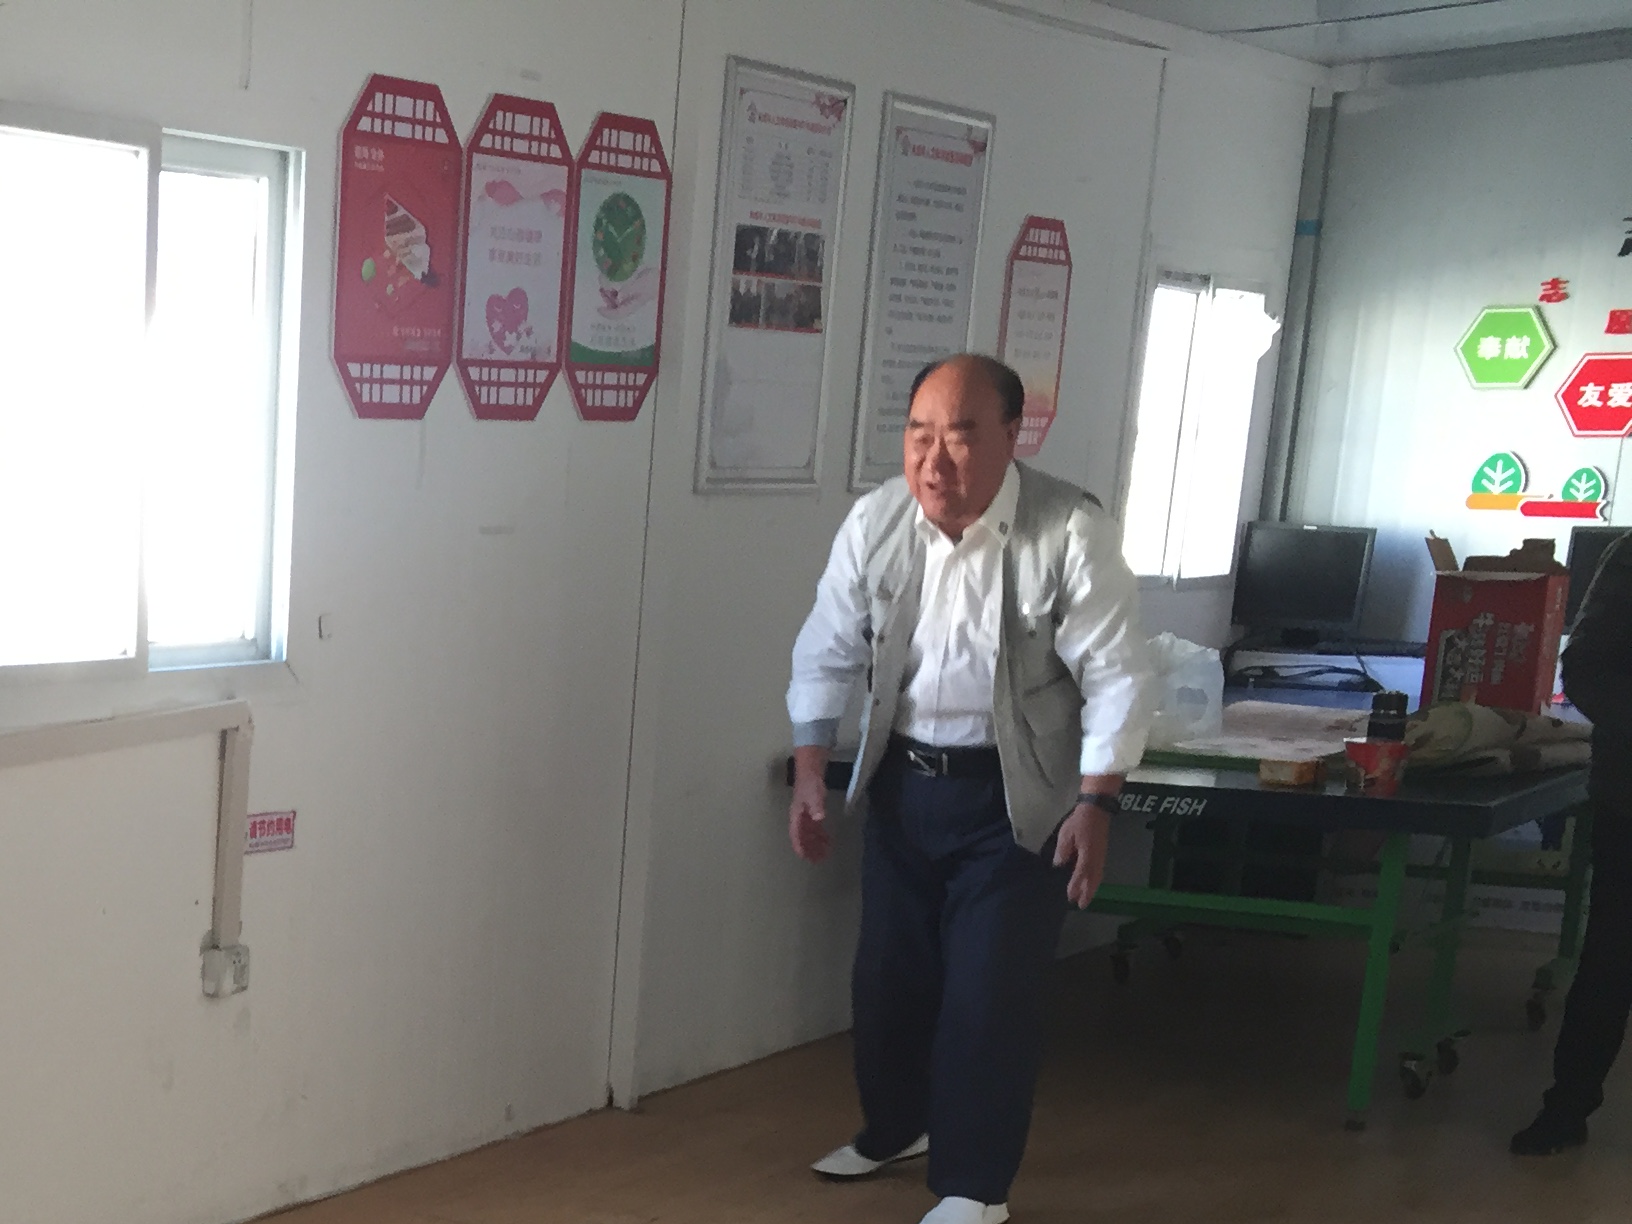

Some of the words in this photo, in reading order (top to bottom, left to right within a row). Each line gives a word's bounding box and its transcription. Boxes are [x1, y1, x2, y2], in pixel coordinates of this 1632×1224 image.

[1477, 335, 1530, 360] 奉献
[1577, 382, 1632, 408] 友爱
[1118, 793, 1159, 812] BLE
[1159, 797, 1208, 816] FISH
